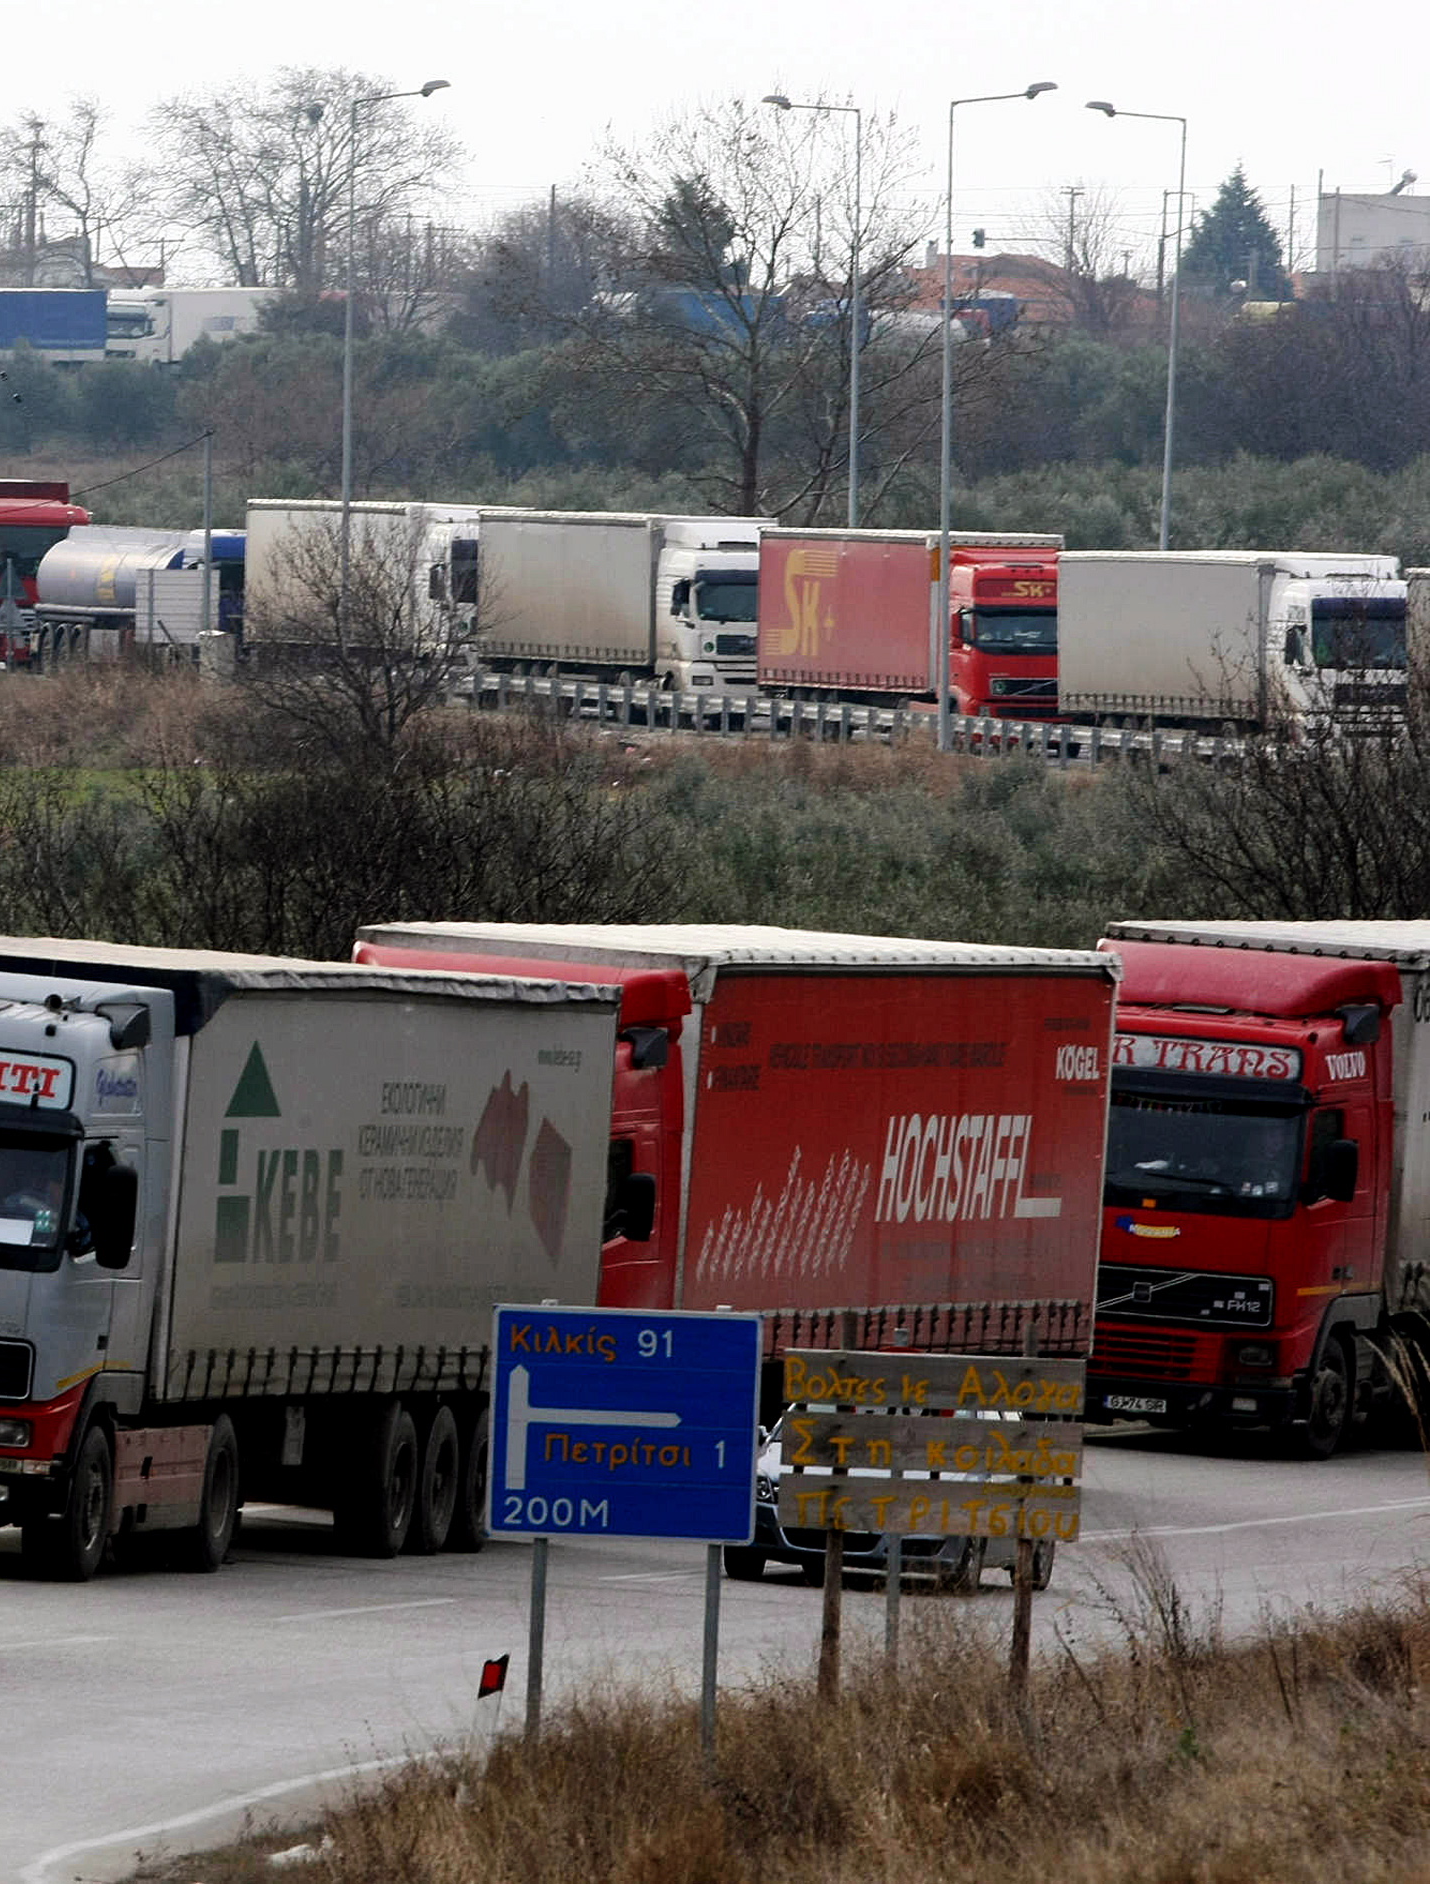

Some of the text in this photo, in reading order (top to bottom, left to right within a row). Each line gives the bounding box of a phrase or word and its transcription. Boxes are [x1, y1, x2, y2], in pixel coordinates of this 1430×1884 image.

[1153, 1040, 1291, 1080] TRANS
[1325, 1050, 1367, 1081] VOLVO
[1226, 1299, 1262, 1313] FH12
[510, 1324, 674, 1362] Κιλκίς 91
[544, 1432, 725, 1471] Πετρίτσι 1
